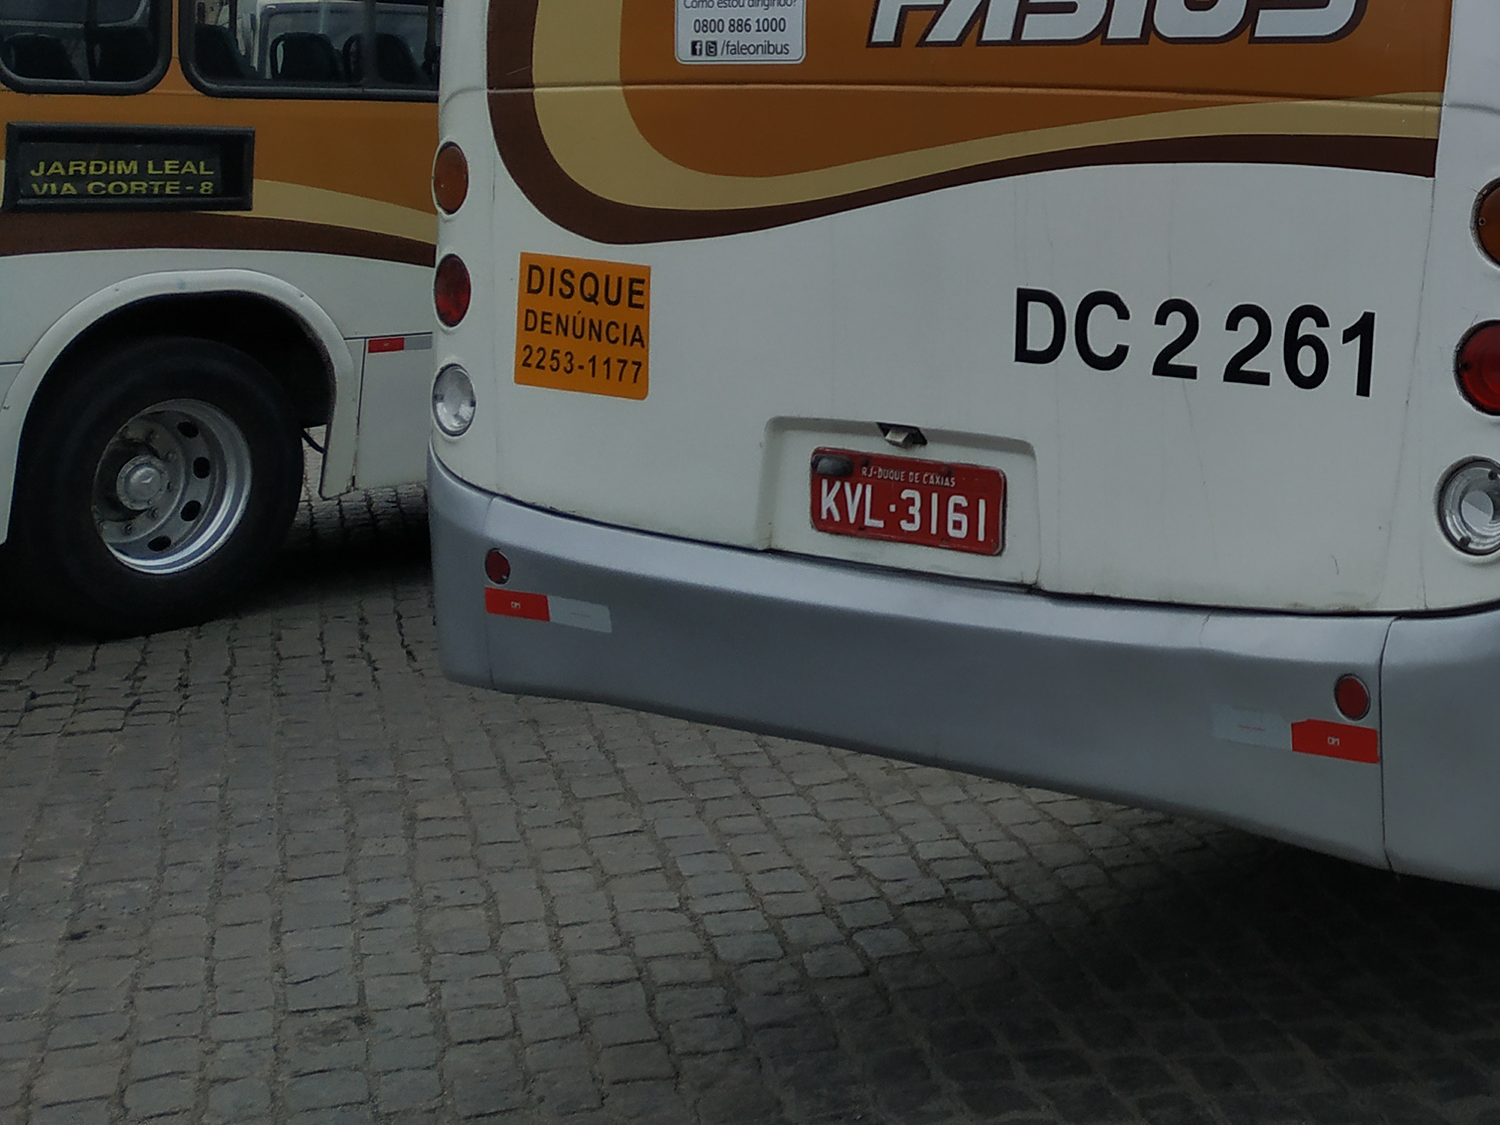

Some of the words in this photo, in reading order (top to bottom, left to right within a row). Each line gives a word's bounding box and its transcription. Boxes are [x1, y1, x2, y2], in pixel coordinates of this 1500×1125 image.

[693, 18, 725, 33] 0800
[728, 18, 752, 33] 886
[755, 17, 787, 33] 1000
[720, 39, 790, 56] /faleonibus
[30, 160, 138, 176] JARDIM
[147, 160, 215, 175] LEAL
[31, 182, 77, 196] VIA
[526, 264, 645, 309] DISQUE
[524, 309, 645, 348] DENÚNCIA
[1014, 287, 1131, 371] DC
[521, 344, 642, 384] 2253-1177
[909, 472, 920, 484] DE
[922, 472, 956, 488] CAXIAS
